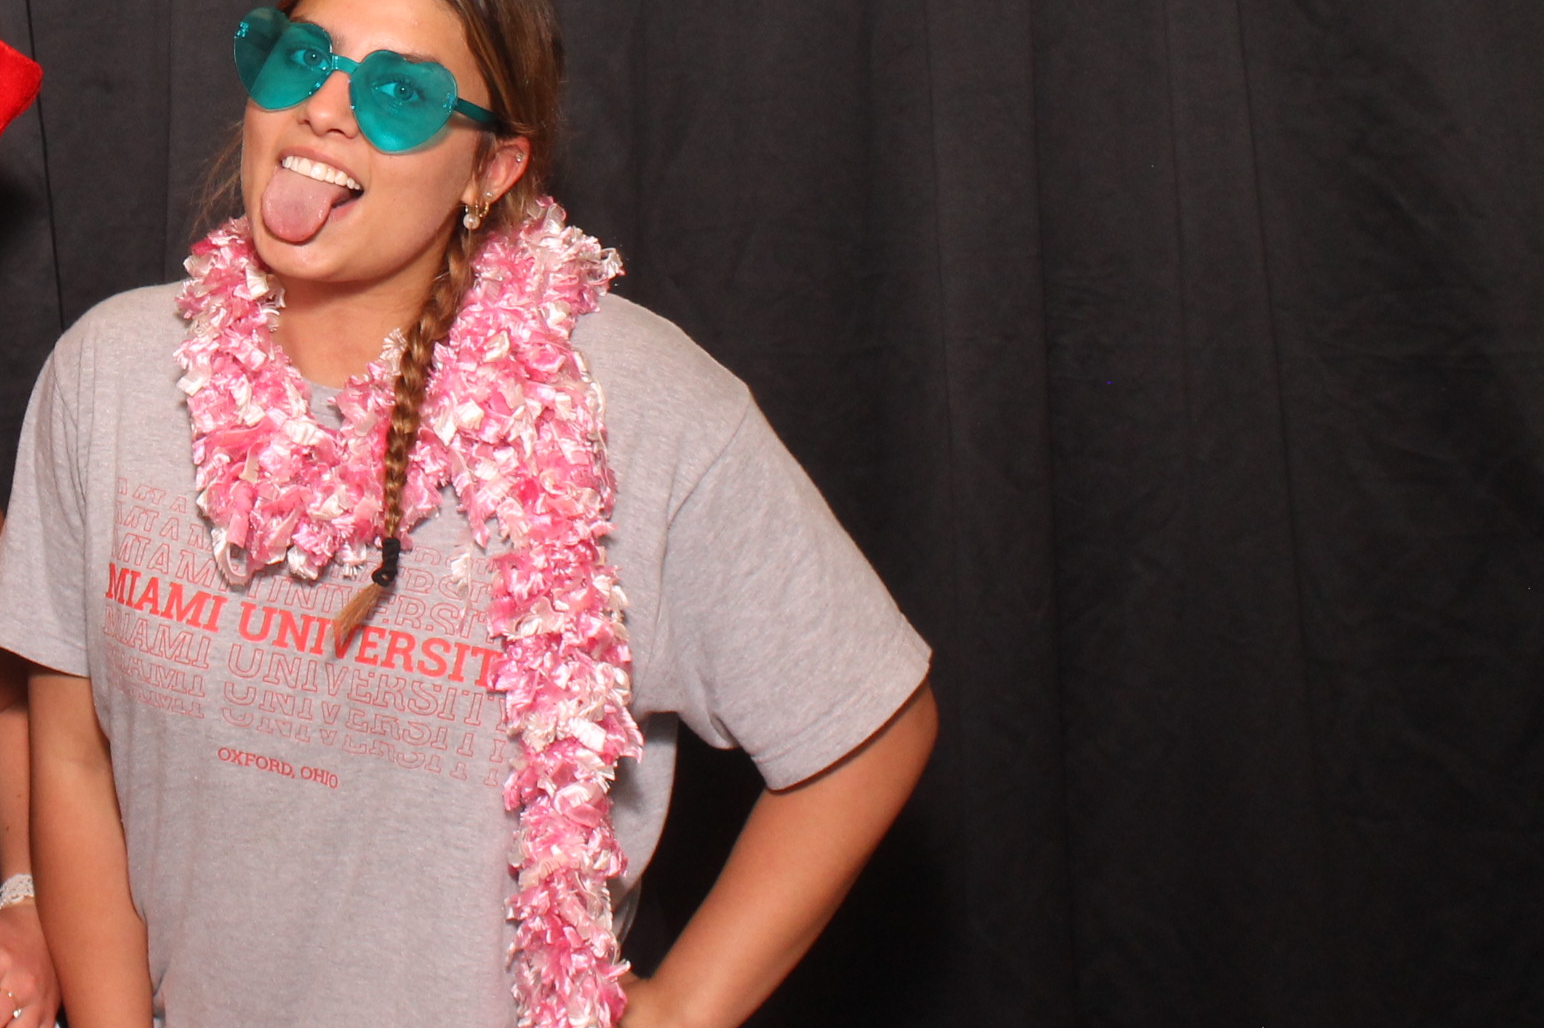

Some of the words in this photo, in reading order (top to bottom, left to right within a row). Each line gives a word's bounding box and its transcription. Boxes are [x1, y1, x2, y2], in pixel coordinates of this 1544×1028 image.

[103, 604, 211, 670] MIAMI
[105, 562, 228, 633] MIAMI
[238, 601, 504, 692] UNIVERSIT
[217, 747, 296, 779] OXFORD,
[300, 766, 339, 789] OHIO
